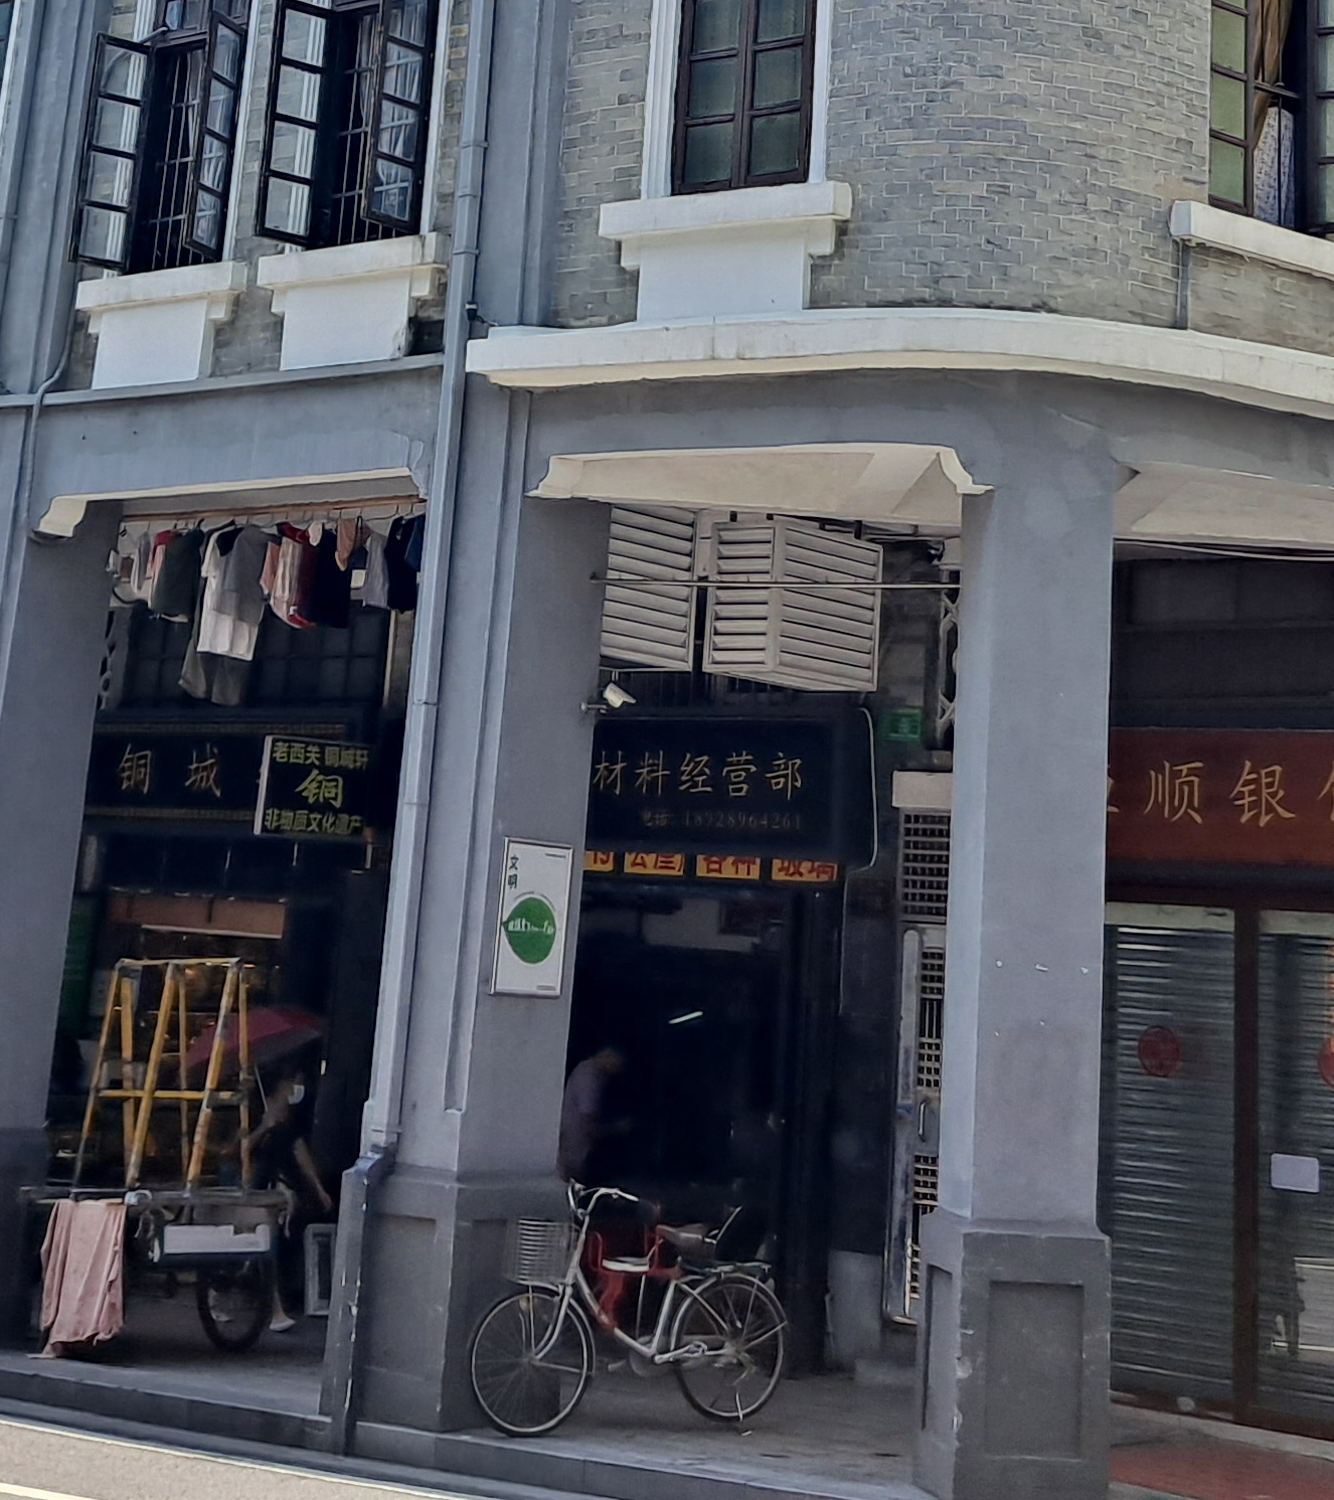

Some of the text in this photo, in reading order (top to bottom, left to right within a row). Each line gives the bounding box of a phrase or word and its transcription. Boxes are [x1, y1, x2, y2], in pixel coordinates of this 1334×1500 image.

[295, 768, 343, 809] 铜
[593, 750, 803, 800] 材料经营部
